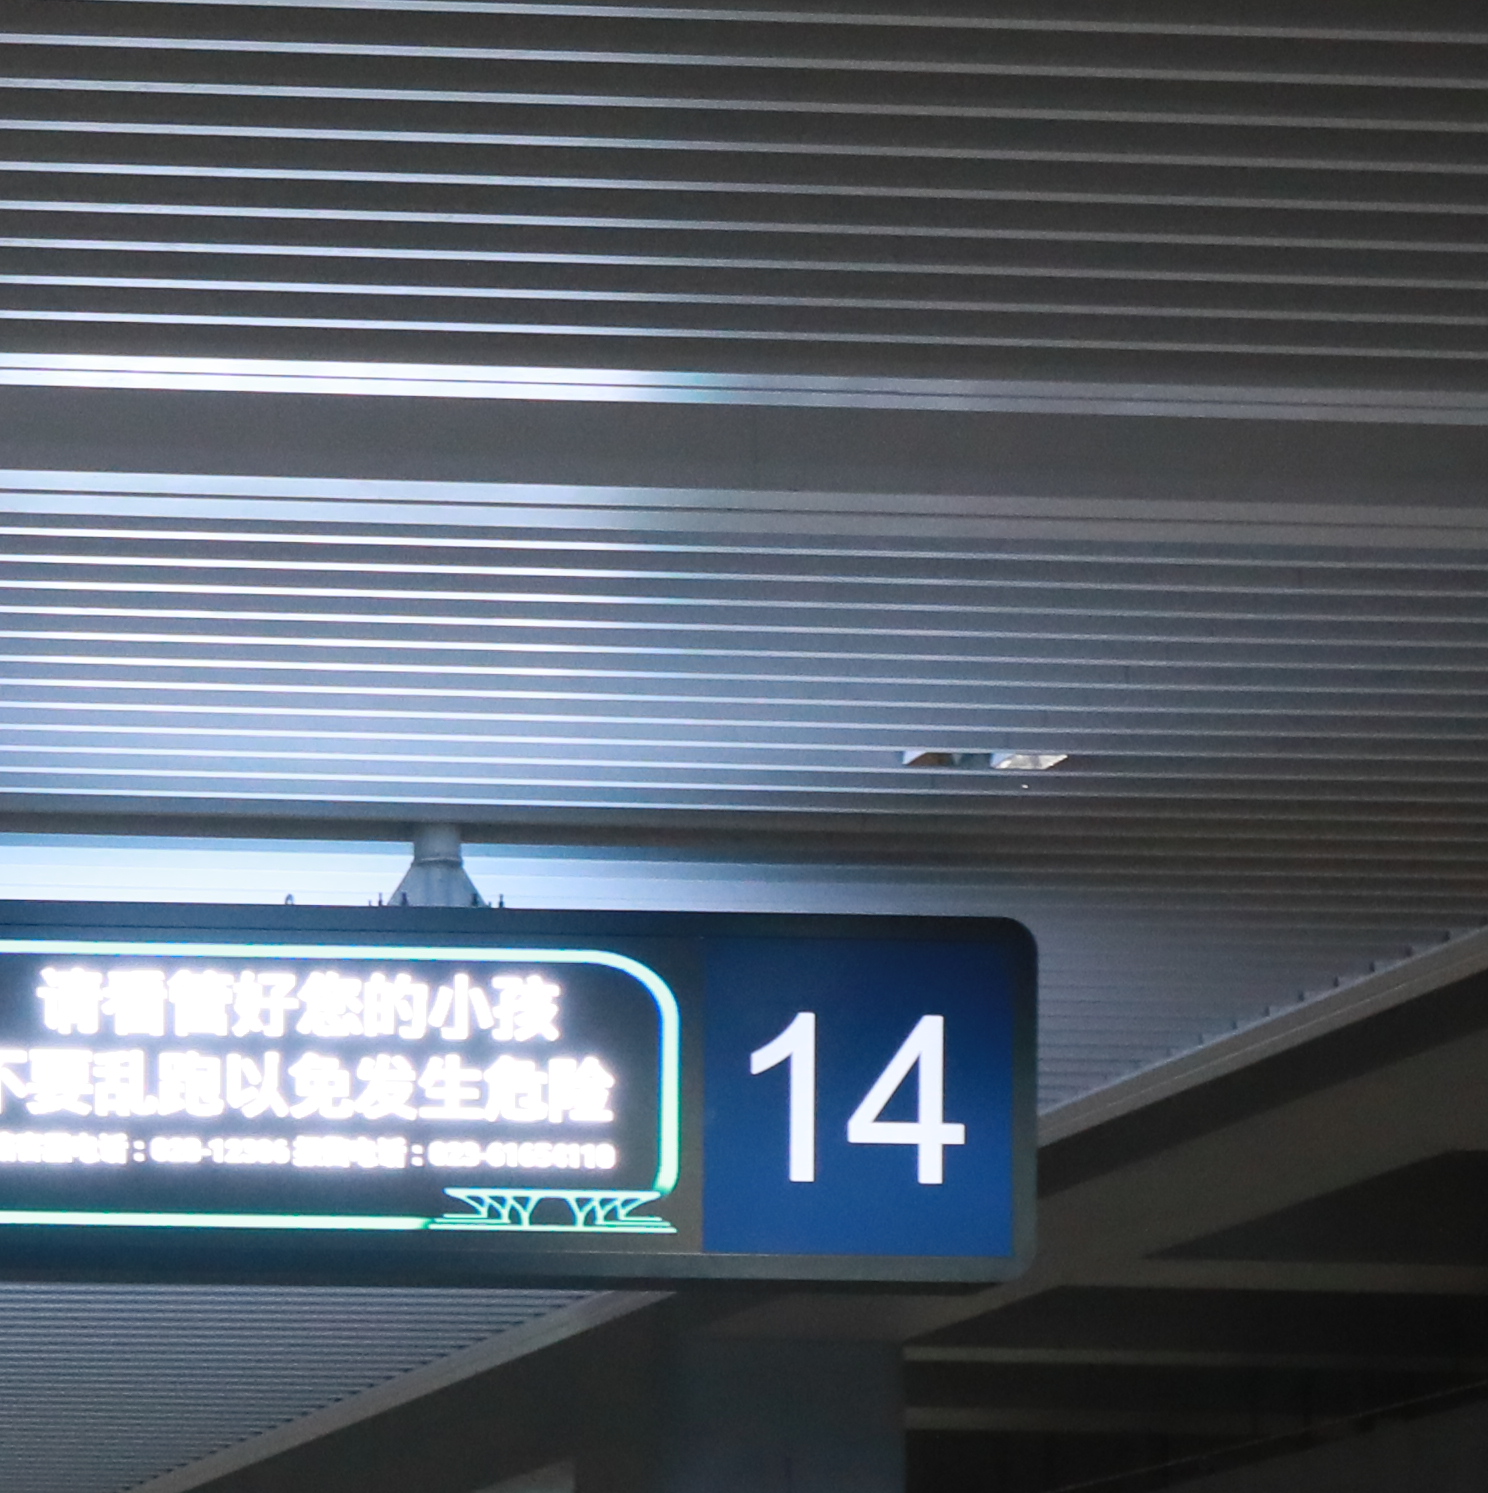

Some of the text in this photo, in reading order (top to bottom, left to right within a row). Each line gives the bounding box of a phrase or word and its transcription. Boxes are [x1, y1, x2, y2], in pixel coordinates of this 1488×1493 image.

[36, 967, 560, 1042] 请看管好您的小孩
[750, 1011, 966, 1185] 14
